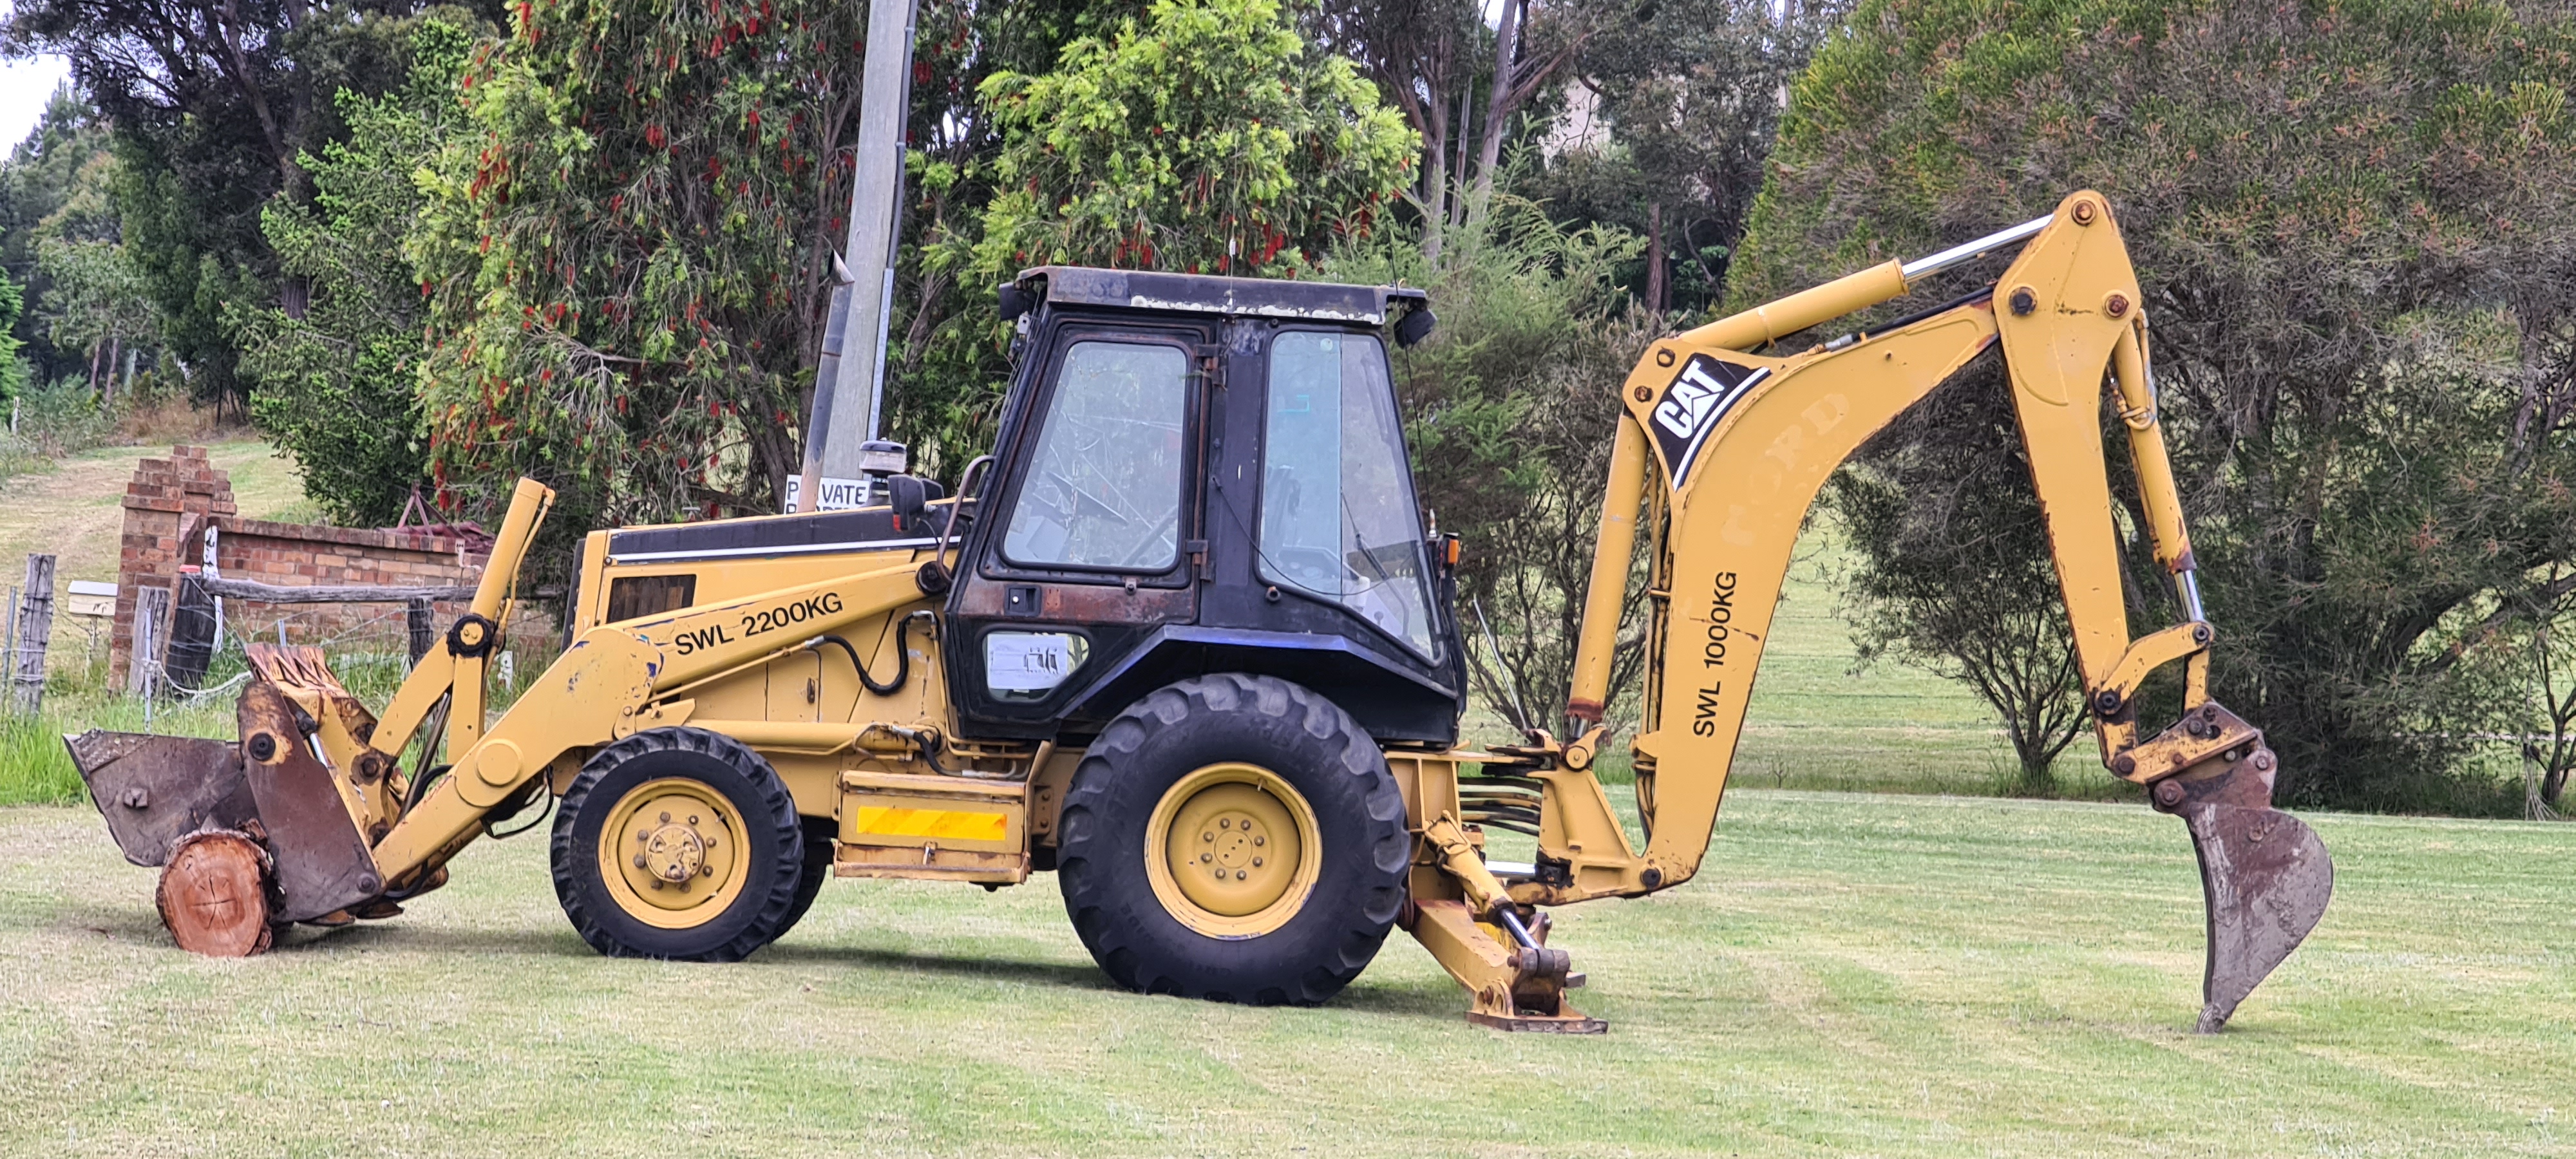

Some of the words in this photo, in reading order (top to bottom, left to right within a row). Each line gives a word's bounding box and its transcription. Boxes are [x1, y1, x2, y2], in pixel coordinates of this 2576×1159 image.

[1655, 358, 1725, 439] CAT
[787, 482, 866, 505] PVATE
[675, 625, 735, 655] SWL
[742, 592, 843, 637] 2200KG
[1704, 572, 1737, 668] 1000KG
[1693, 681, 1721, 737] SWL
